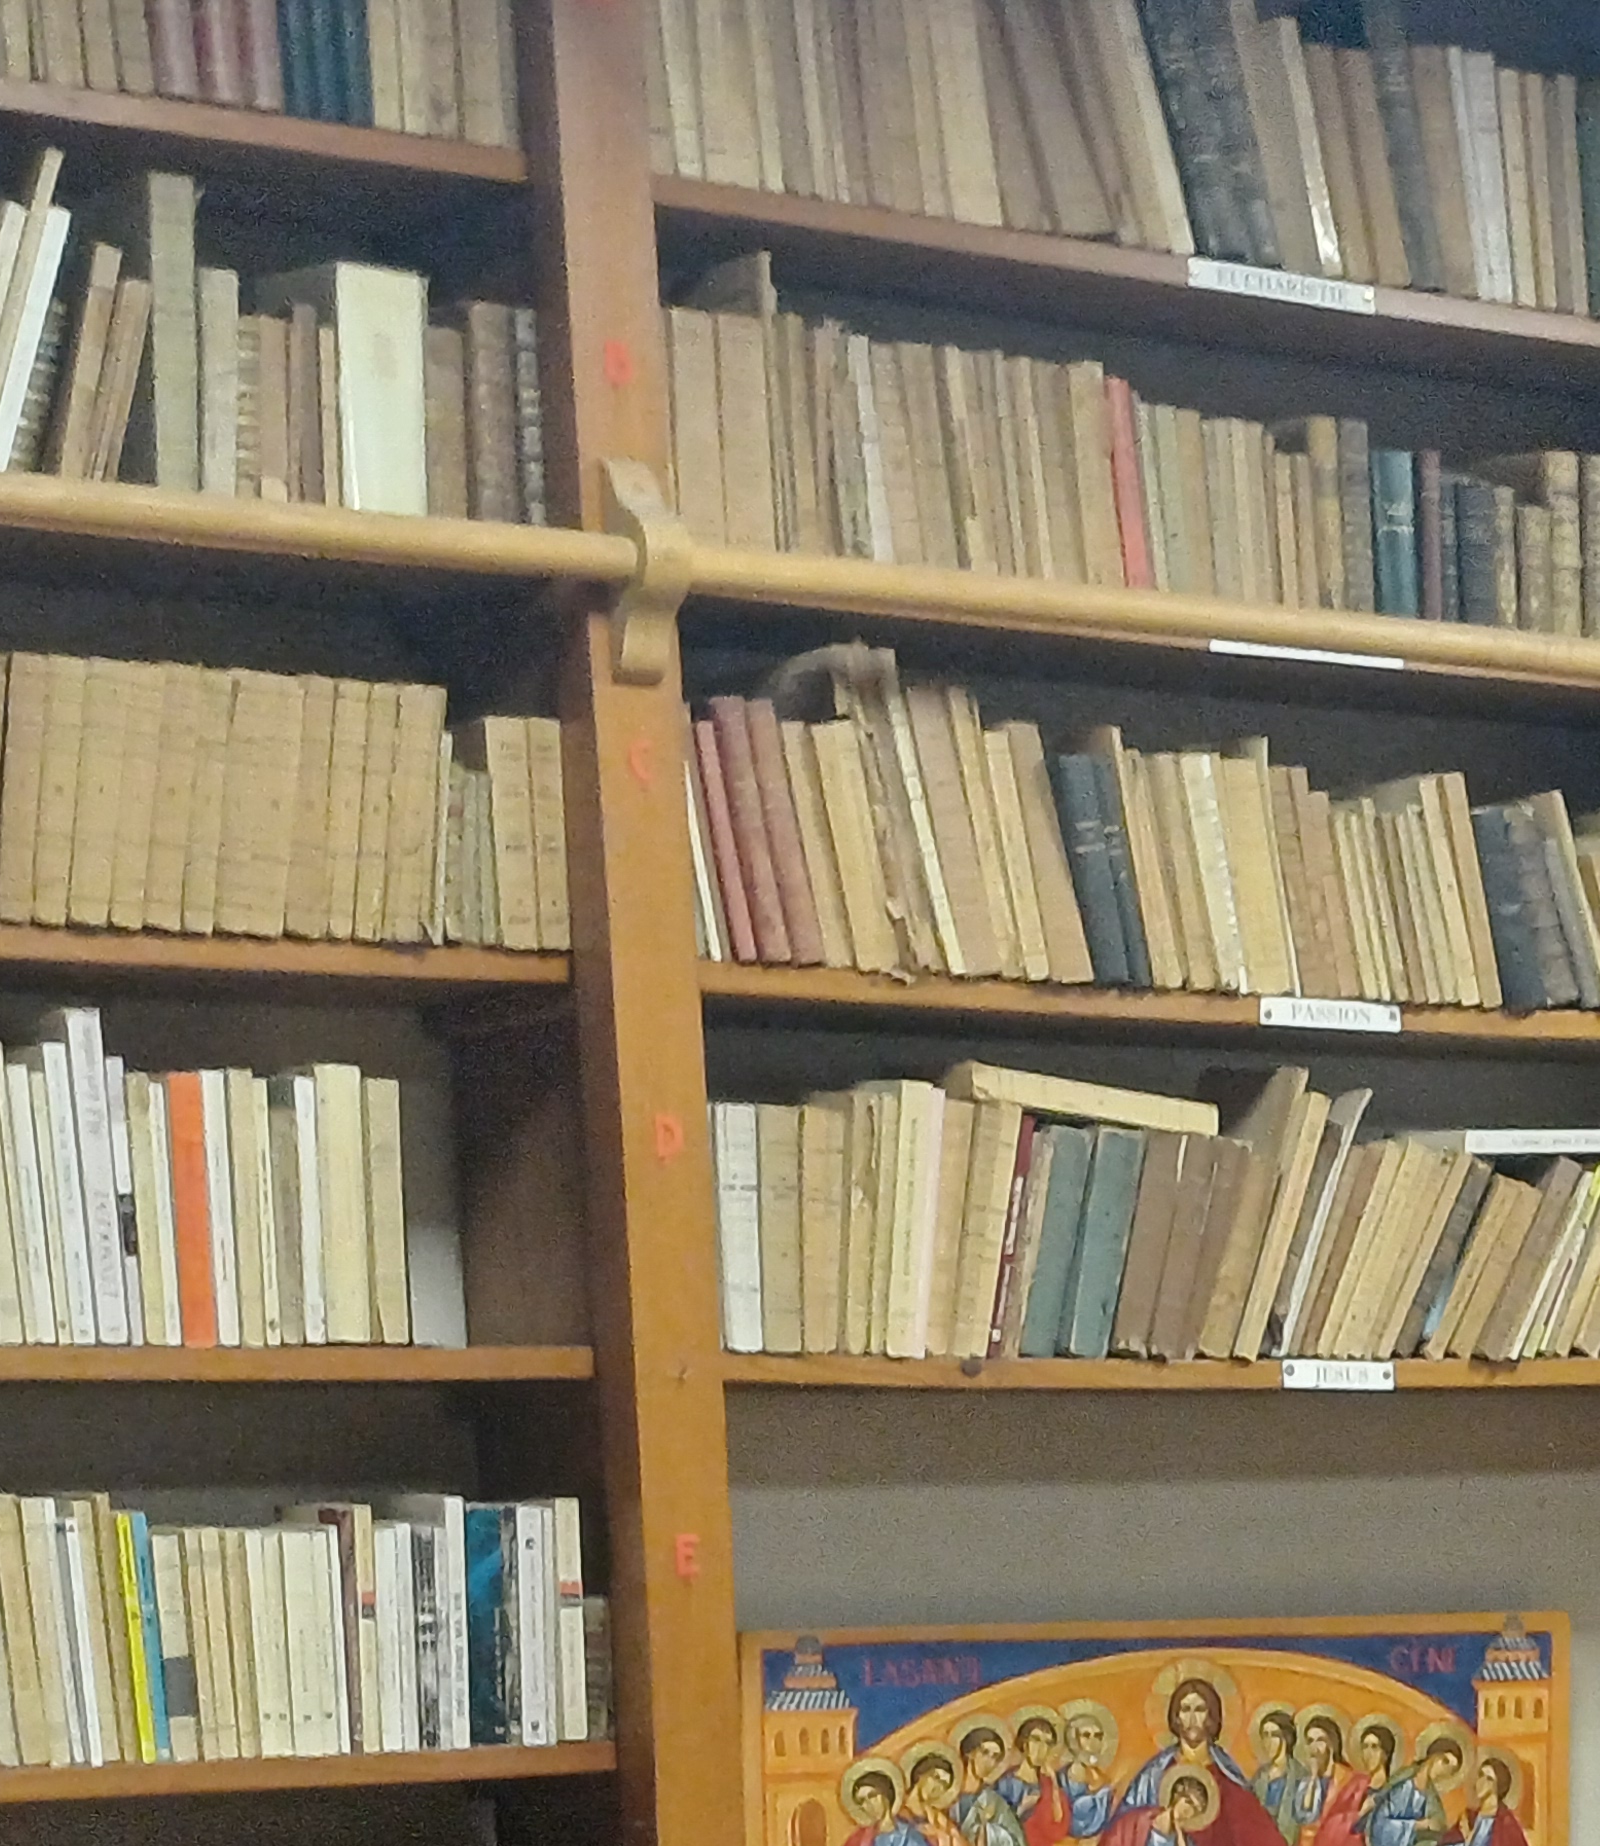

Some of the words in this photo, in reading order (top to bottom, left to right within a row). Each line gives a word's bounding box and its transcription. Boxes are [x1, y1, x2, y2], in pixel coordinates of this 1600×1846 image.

[1216, 268, 1343, 303] EUCHARISTIE
[1291, 1003, 1371, 1025] PASSION
[653, 1112, 685, 1162] D
[675, 1533, 700, 1581] E
